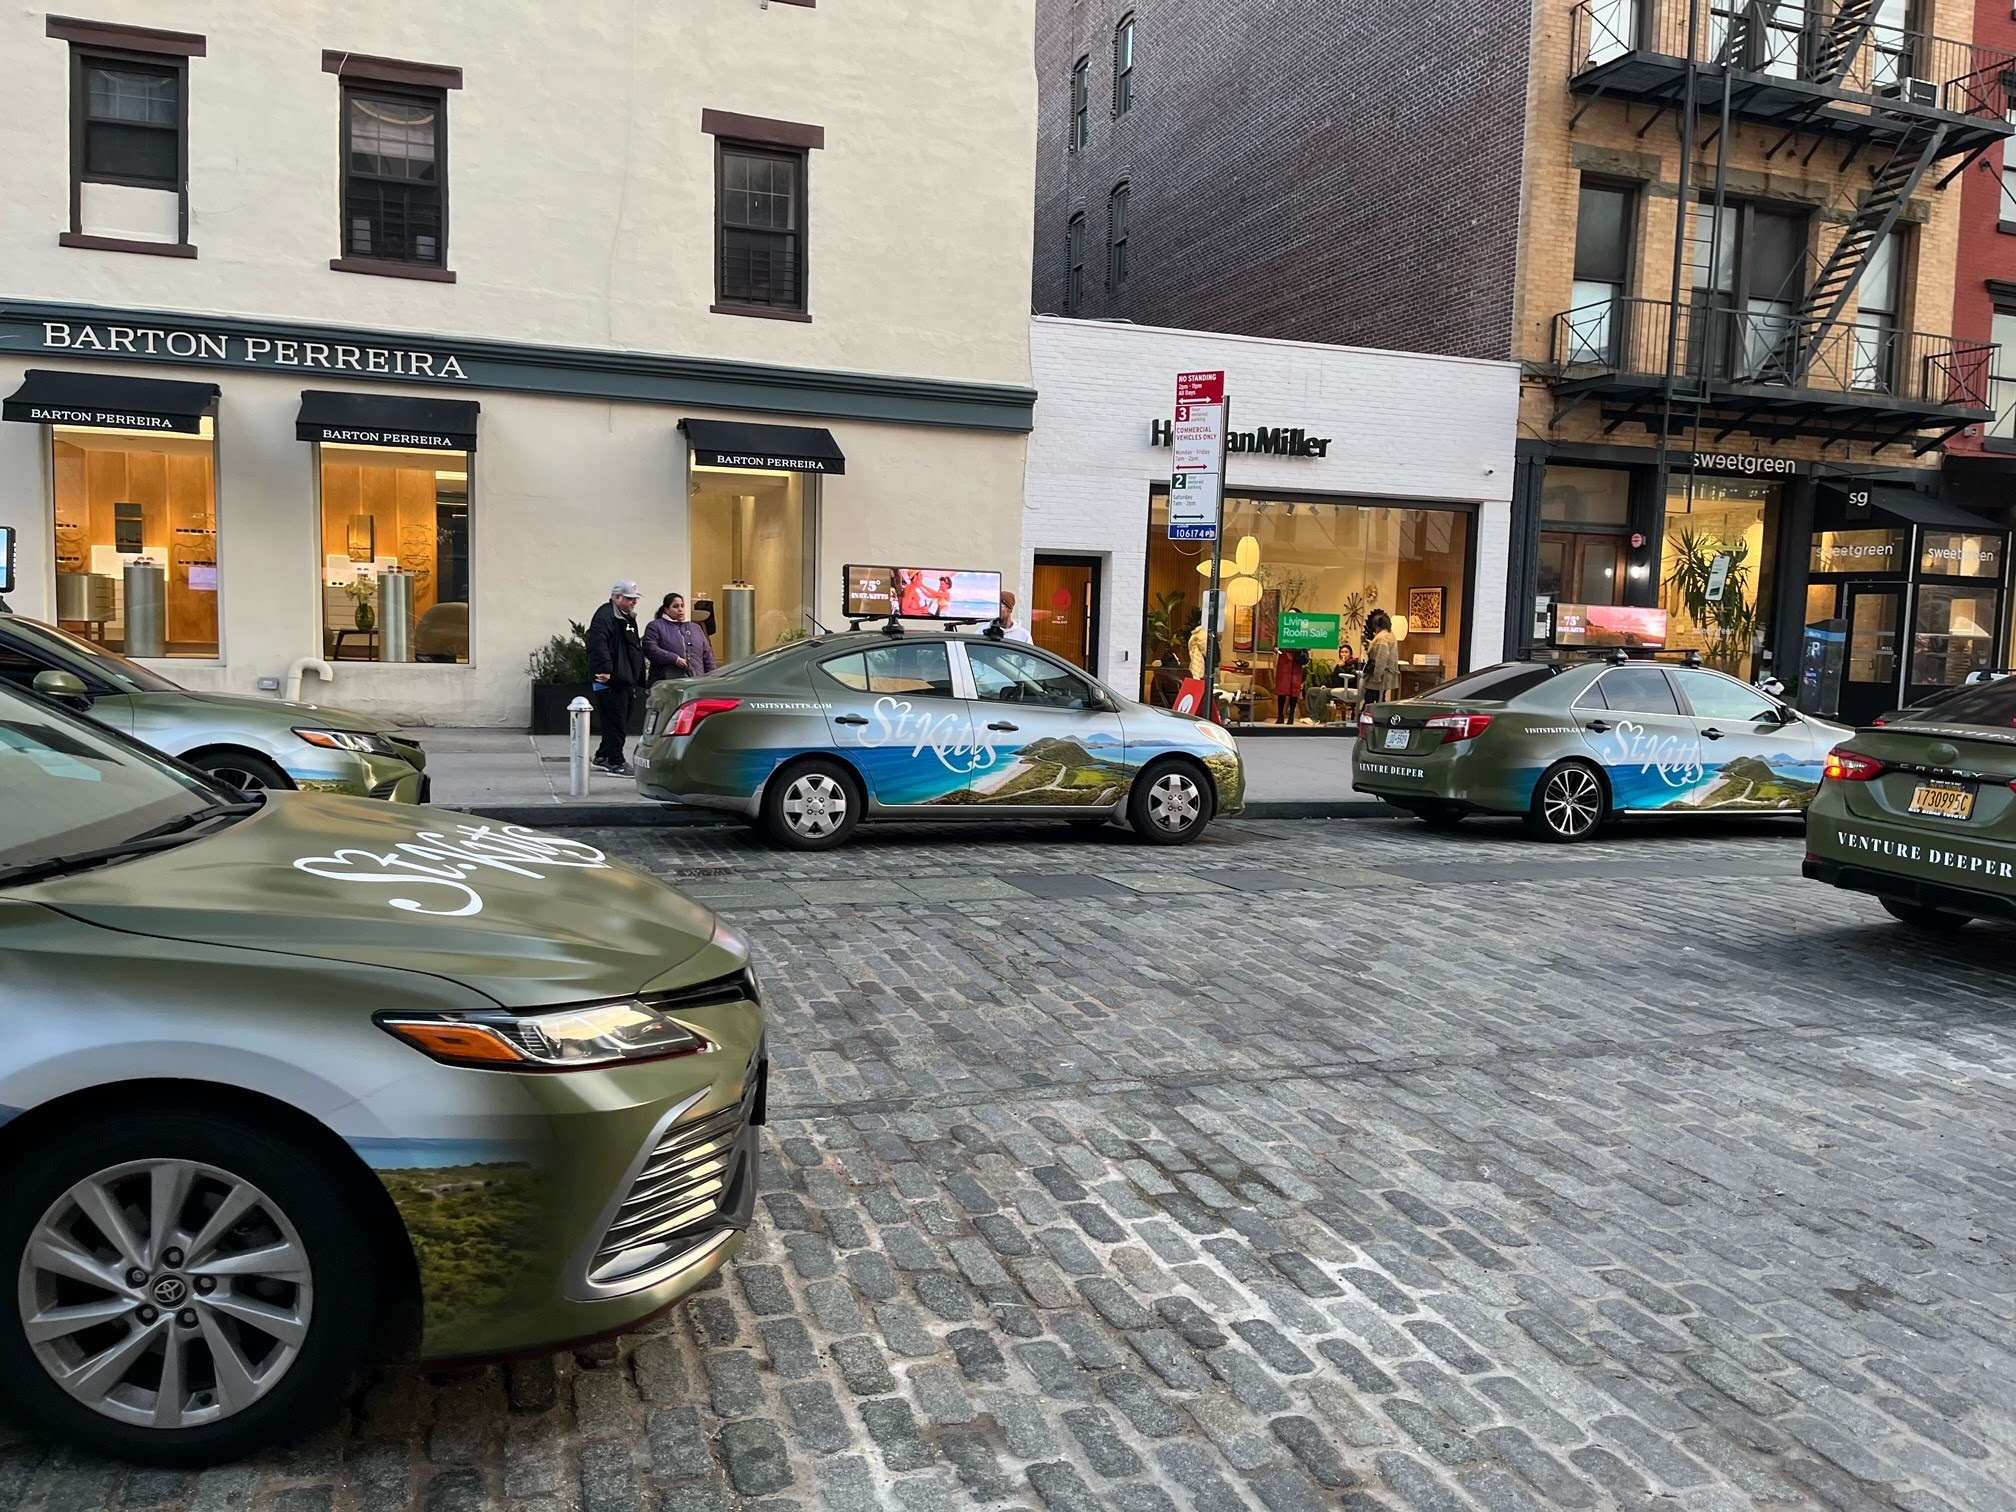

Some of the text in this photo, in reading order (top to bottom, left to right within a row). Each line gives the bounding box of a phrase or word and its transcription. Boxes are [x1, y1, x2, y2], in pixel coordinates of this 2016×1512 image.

[43, 322, 468, 379] BARTON PERREIRA
[1188, 374, 1217, 382] STANDING
[30, 409, 172, 428] BARTON PERREIRA
[1179, 407, 1187, 420] 3
[323, 429, 453, 446] BARTON PERREIRA
[717, 455, 824, 470] BARTON PERREIRA
[1694, 453, 1796, 474] sweetgreen
[1175, 475, 1183, 488] 2
[1849, 491, 1868, 507] sg
[1176, 529, 1204, 537] 106174
[1816, 544, 1893, 558] seetgreen
[1928, 548, 1994, 561] sweeten
[860, 579, 881, 592] 75°
[1283, 616, 1308, 628] Living
[1283, 628, 1328, 638] Room Sale
[857, 697, 1003, 774] St. Kitts
[1603, 720, 1709, 788] St. Kitts
[1360, 763, 1424, 778] VENTURE DEEPER
[1900, 763, 1984, 777] CAMRY
[1917, 789, 1968, 811] T730995C
[1943, 812, 1966, 820] TOYOTA
[1838, 831, 2012, 878] VENTURE DEEPER
[293, 825, 612, 916] St. Kitts
